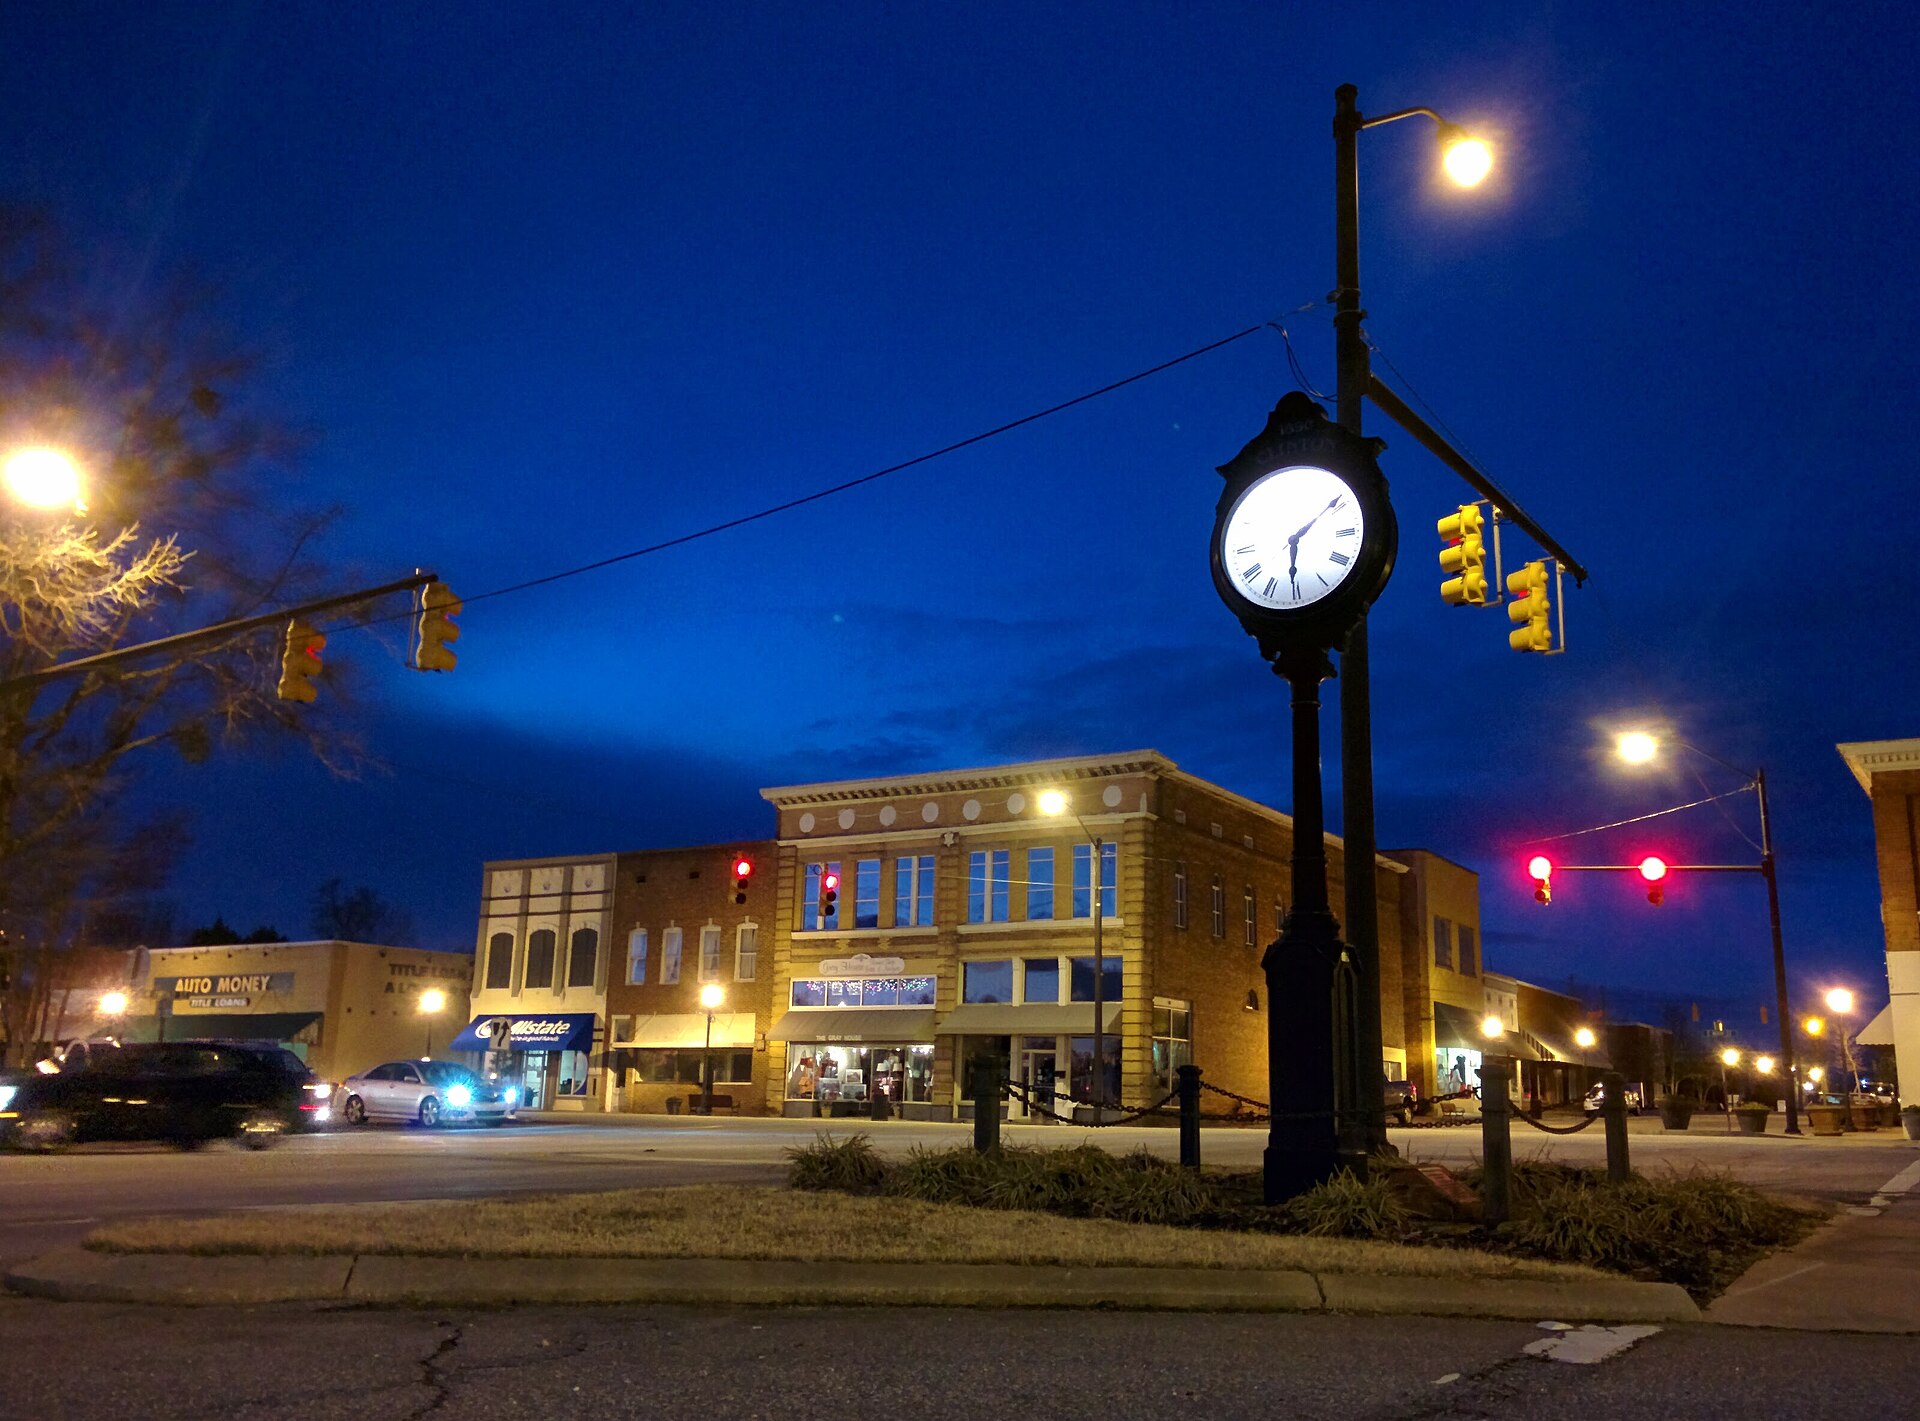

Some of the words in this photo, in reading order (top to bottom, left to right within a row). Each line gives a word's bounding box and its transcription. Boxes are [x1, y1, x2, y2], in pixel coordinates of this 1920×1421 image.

[175, 977, 212, 993] AUTO
[217, 975, 270, 992] MONEY
[191, 998, 211, 1007] TITLE
[214, 997, 248, 1007] LOANS
[511, 1020, 570, 1034] Allstate
